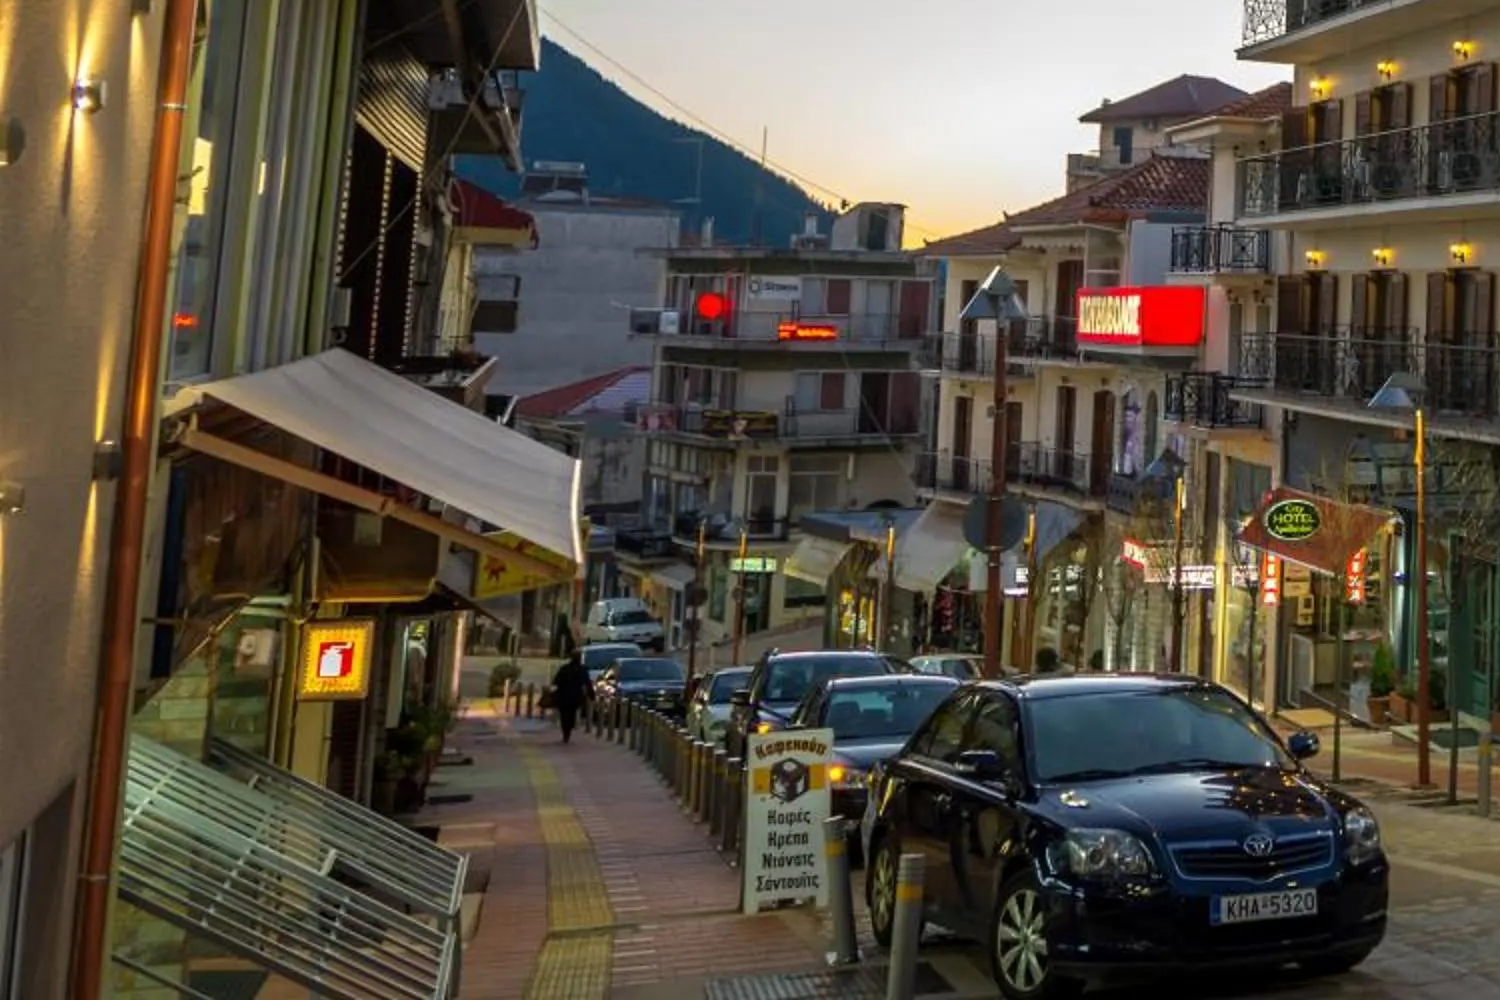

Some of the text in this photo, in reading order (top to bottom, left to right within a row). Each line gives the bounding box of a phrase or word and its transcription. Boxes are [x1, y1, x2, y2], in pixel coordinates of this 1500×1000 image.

[1272, 512, 1316, 524] HOTEL
[767, 808, 811, 825] Καφές
[767, 831, 809, 850] Κρέπα
